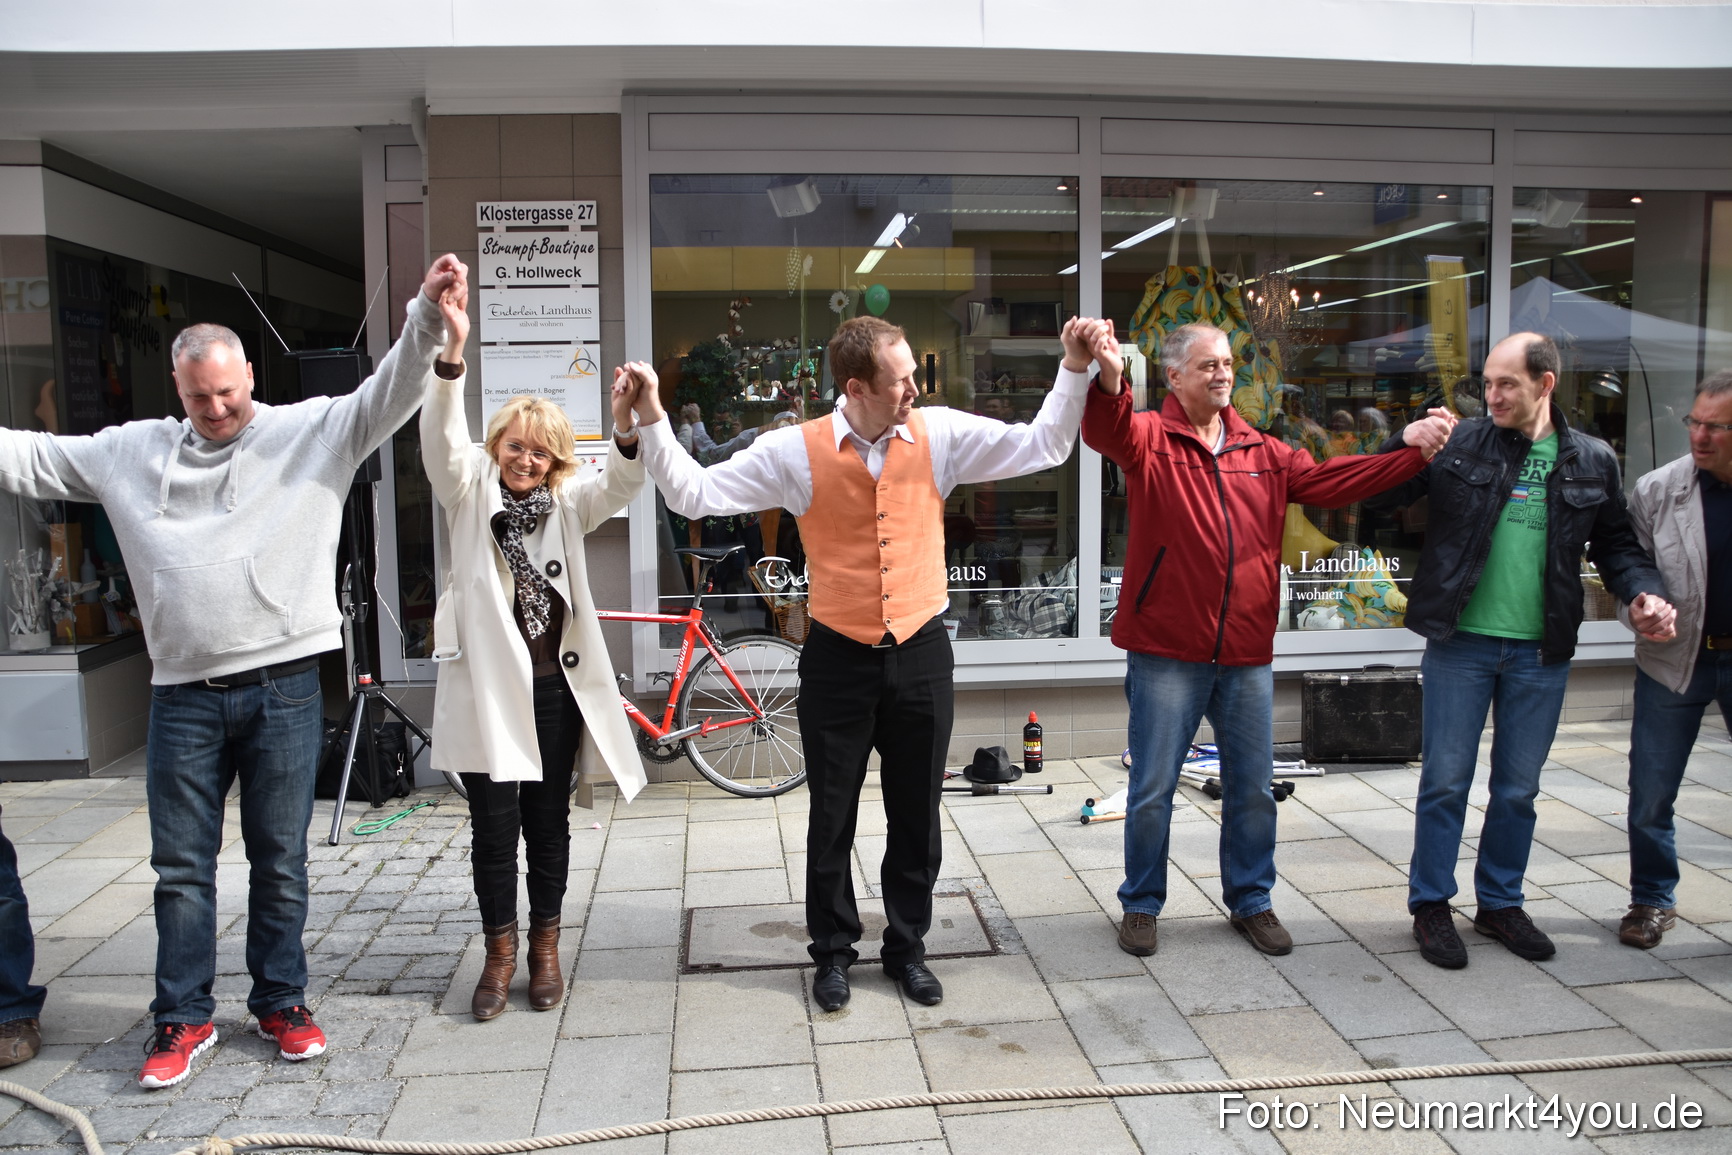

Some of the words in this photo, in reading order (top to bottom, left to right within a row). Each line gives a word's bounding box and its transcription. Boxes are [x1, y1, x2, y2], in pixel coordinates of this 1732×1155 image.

[480, 205, 574, 224] Klostergasse
[577, 204, 594, 220] 27
[482, 236, 595, 262] Strumpf-Boutique
[495, 266, 512, 279] G.
[515, 265, 582, 279] Hollweck
[487, 303, 538, 317] Enderlein
[540, 304, 592, 316] Landhaus
[110, 300, 160, 357] Boutique
[519, 320, 538, 328] stilvoll
[539, 320, 564, 328] wohnen
[511, 387, 537, 395] Günther
[537, 387, 542, 395] J.
[543, 387, 566, 396] Bogner
[1299, 550, 1400, 574] Landhaus
[755, 556, 809, 589] End
[1296, 588, 1343, 601] wohnen
